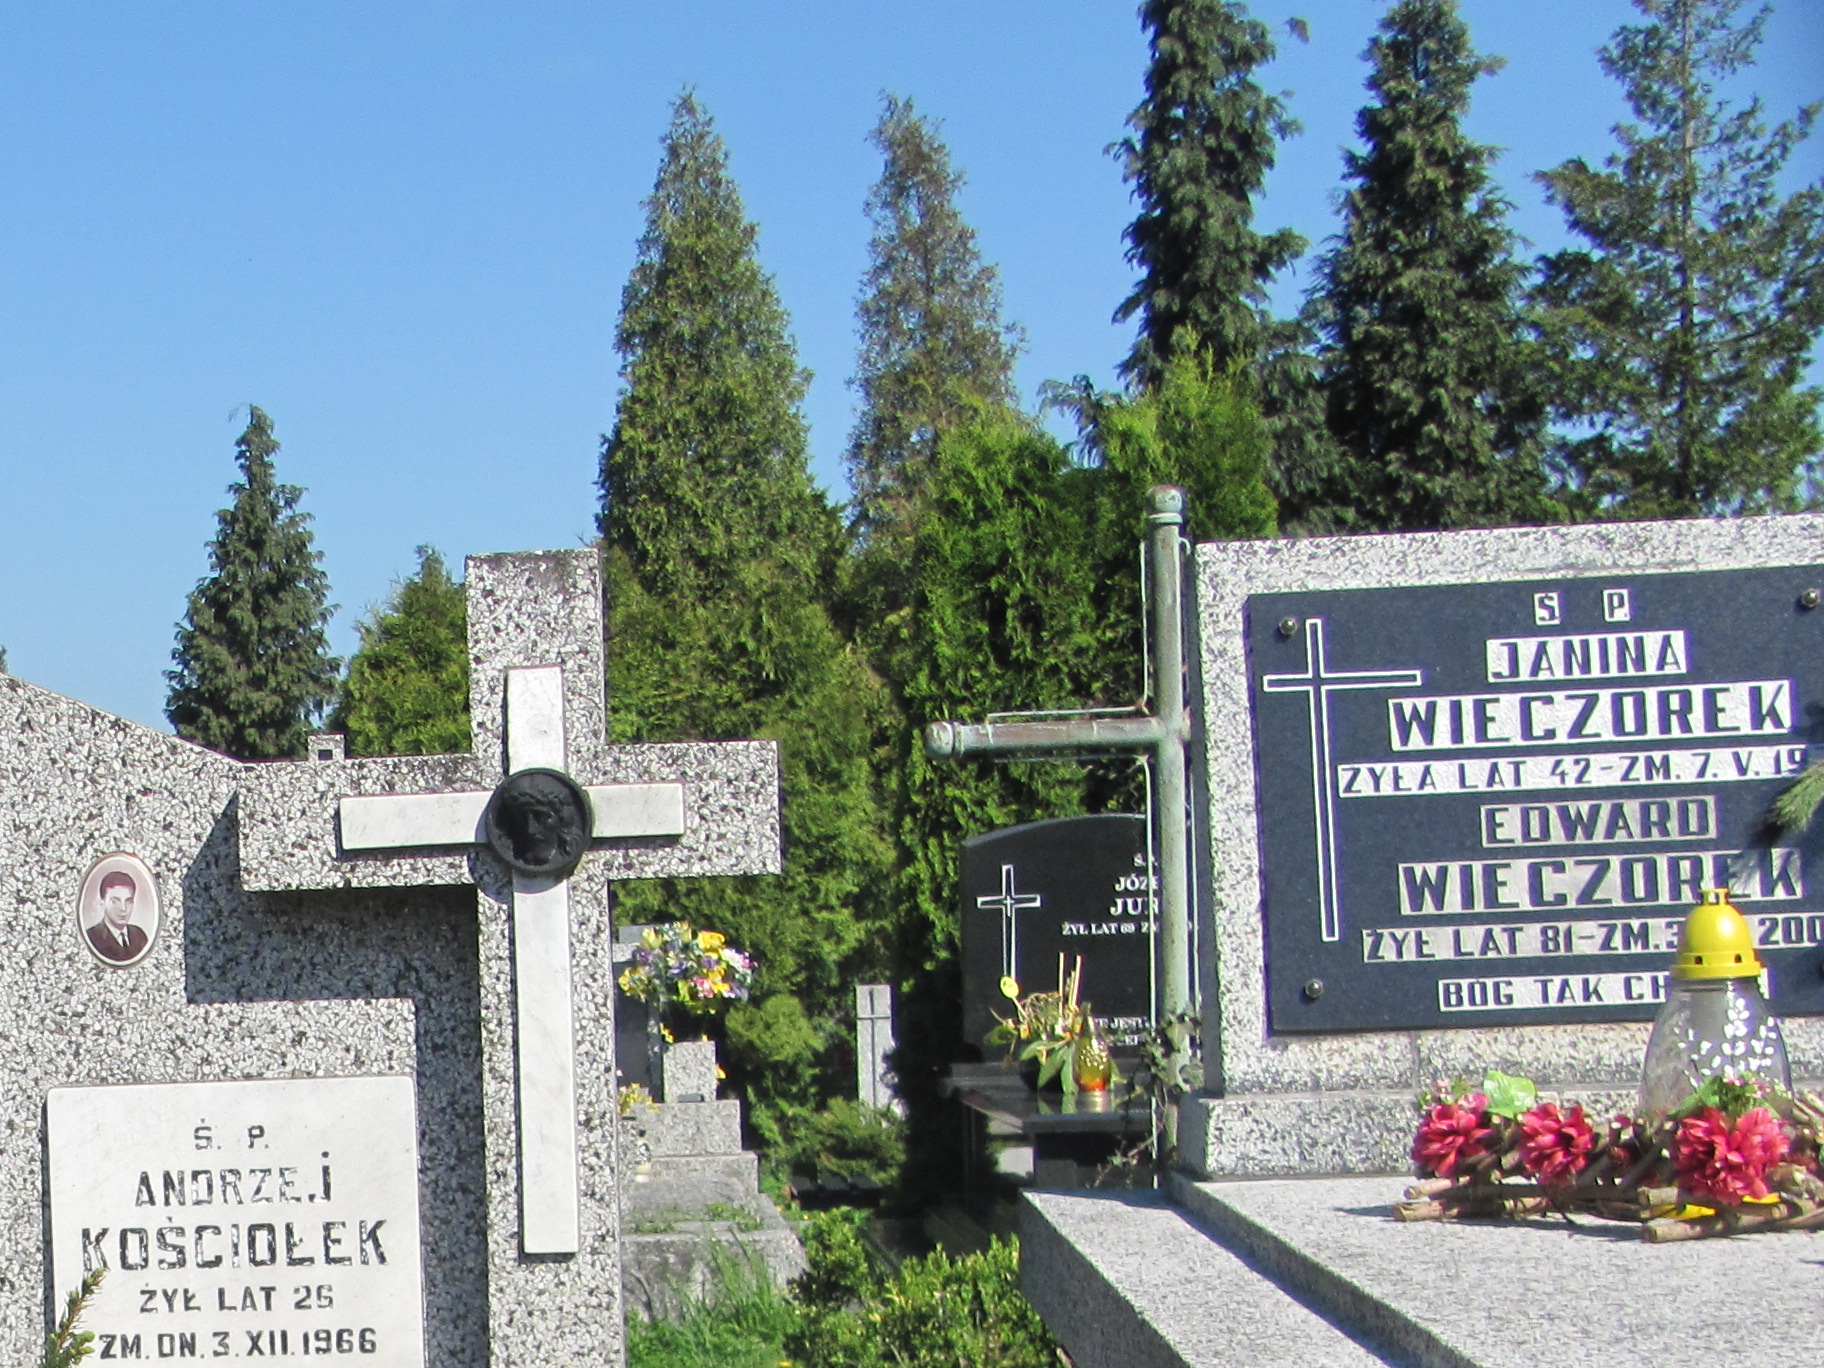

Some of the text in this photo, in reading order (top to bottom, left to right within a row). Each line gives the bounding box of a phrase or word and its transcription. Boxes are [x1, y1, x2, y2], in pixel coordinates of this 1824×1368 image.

[1491, 634, 1682, 680] JANINA
[1391, 683, 1785, 748] WIECZOREK
[1457, 759, 1527, 789] LAT
[1485, 799, 1712, 845] EDWARD
[1403, 850, 1798, 913] WIECZOREK
[1452, 926, 1525, 957] LAT
[1533, 976, 1604, 1005] TAK
[80, 1215, 390, 1273] KOŚCIOŁEK
[139, 1283, 202, 1313] ŻYŁ
[217, 1285, 277, 1312] LAT
